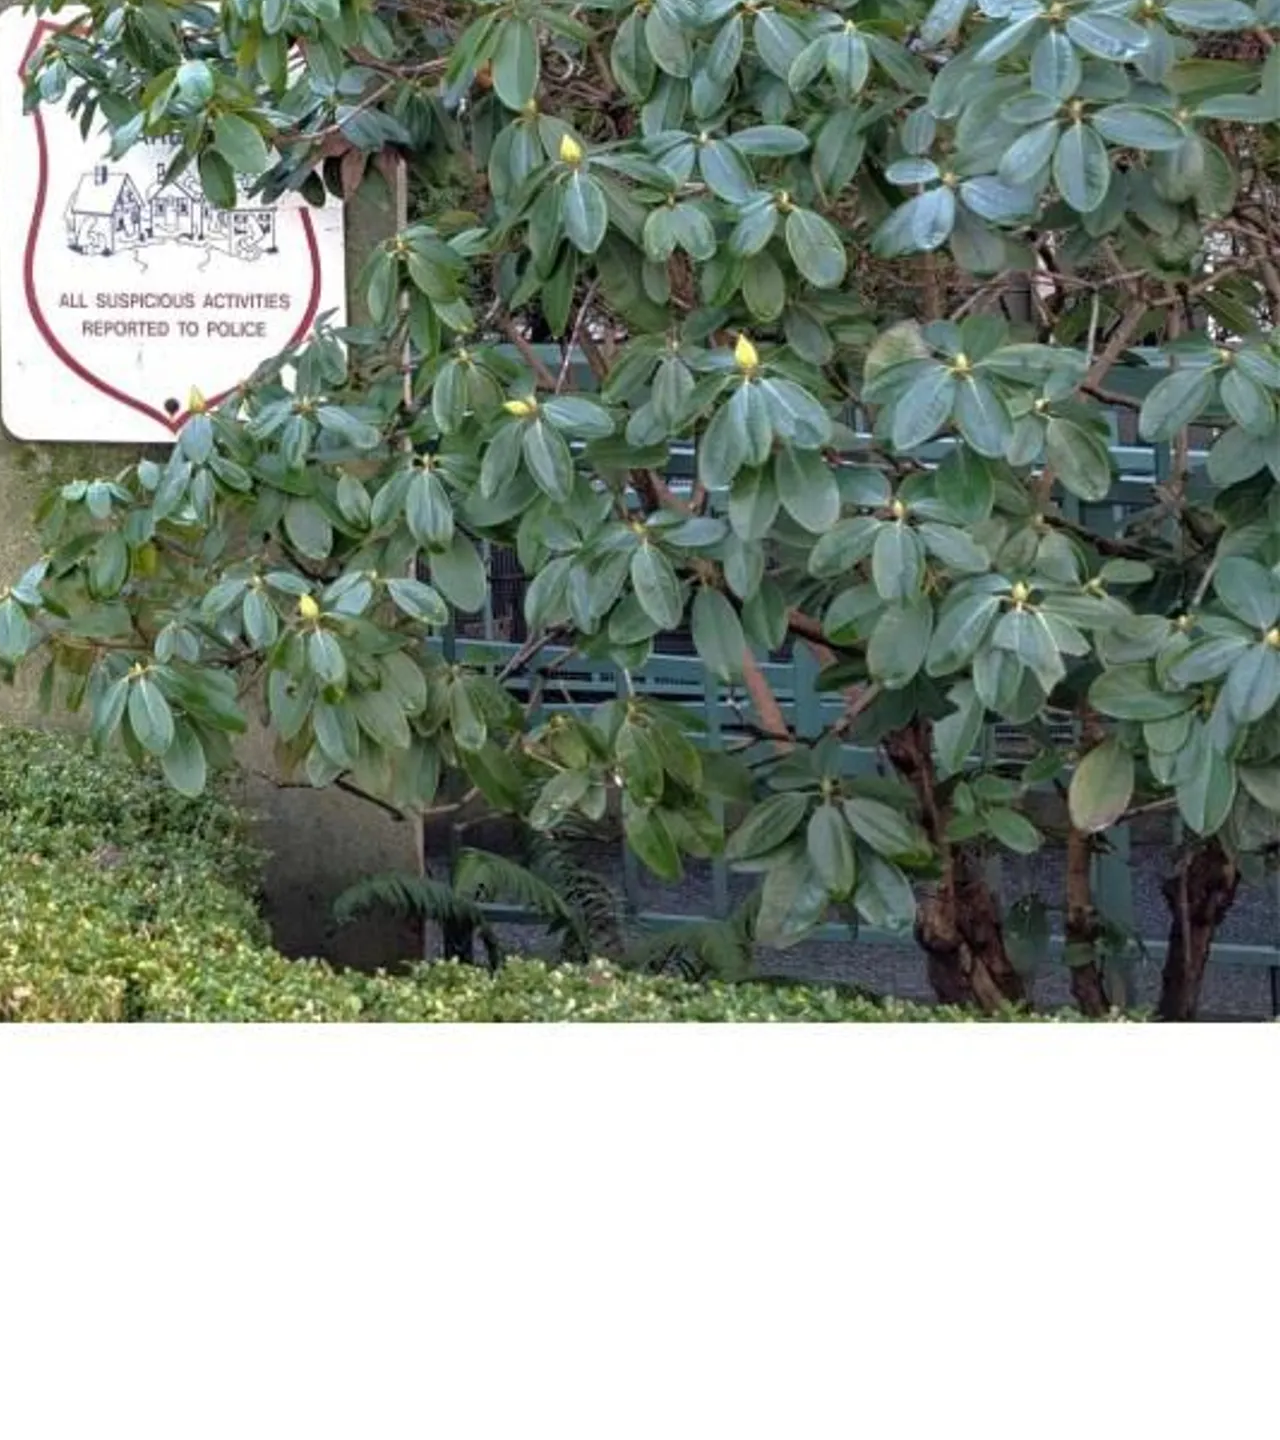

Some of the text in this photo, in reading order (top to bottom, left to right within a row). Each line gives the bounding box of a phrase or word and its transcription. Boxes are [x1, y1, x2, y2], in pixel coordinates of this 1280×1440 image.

[58, 292, 291, 310] ALL SUSPICIOUS ACTIVITIES
[82, 320, 267, 338] REPORTED TO POLICE
